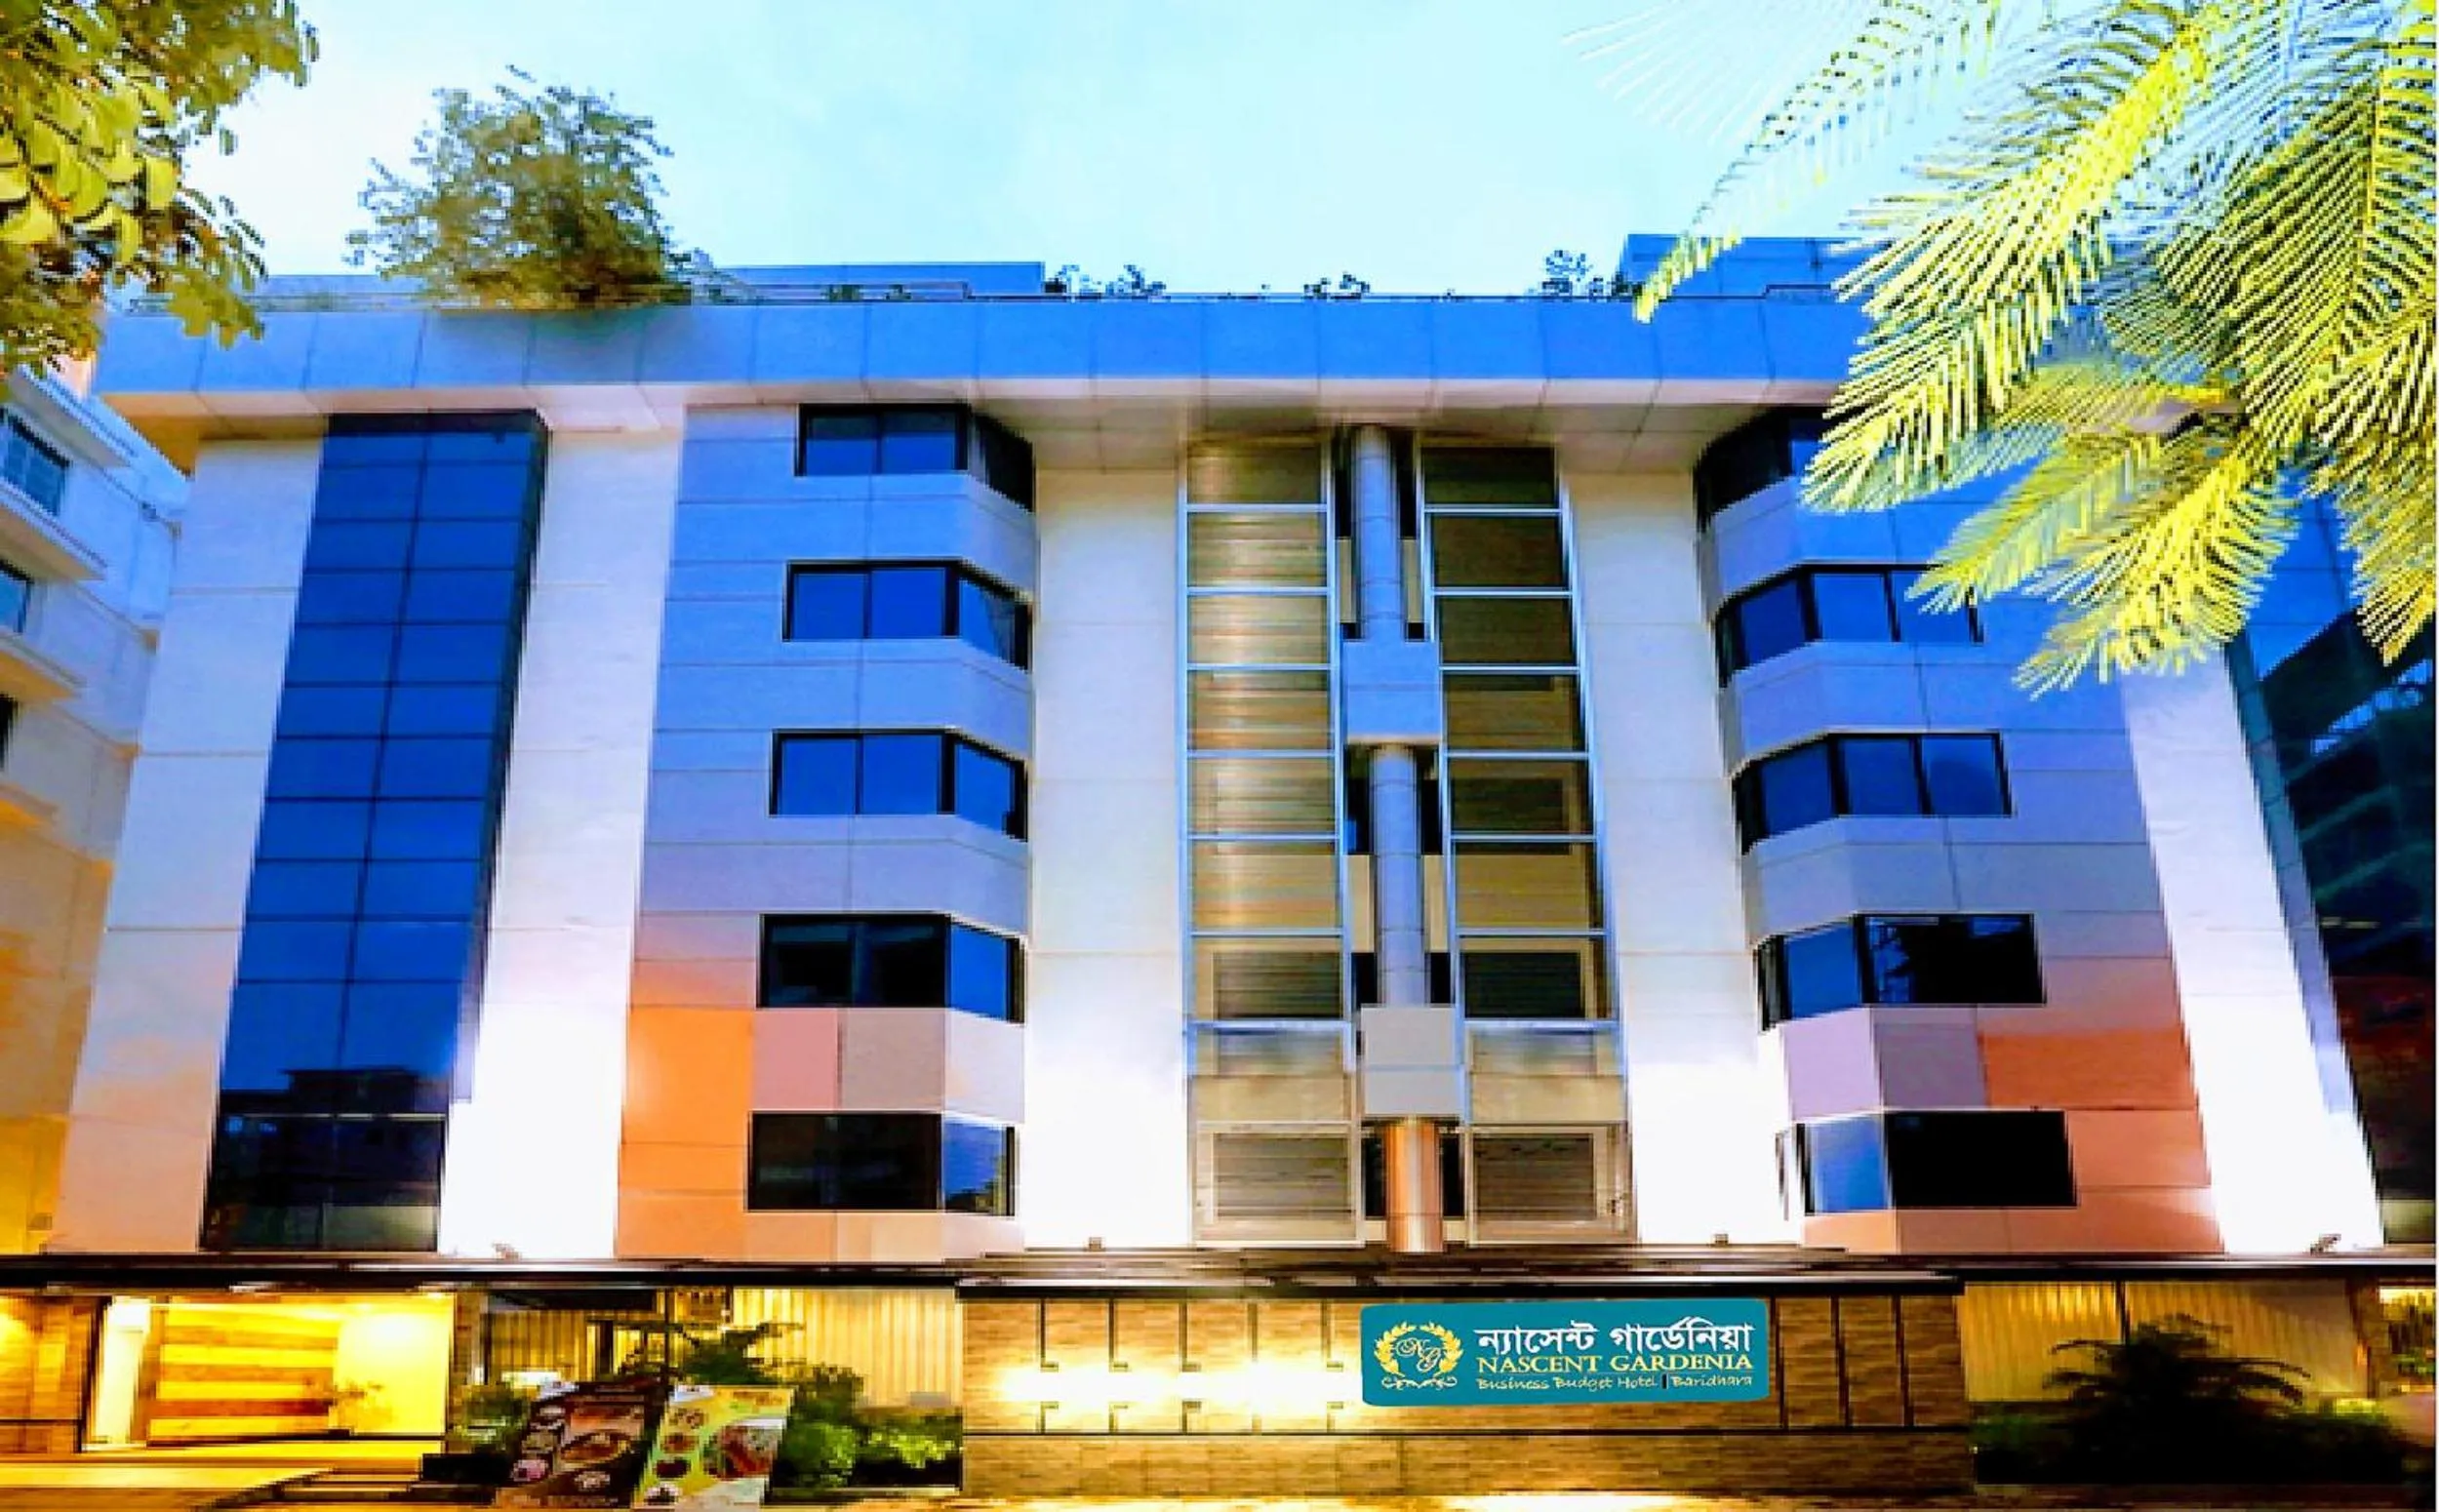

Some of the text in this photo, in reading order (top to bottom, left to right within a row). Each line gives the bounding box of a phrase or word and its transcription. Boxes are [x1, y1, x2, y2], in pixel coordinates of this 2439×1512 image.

[1473, 1316, 1755, 1355] ন্যাসেন্ট গার্ডেনিয়া
[1476, 1353, 1753, 1373] NASCENT GARDENIA
[1476, 1373, 1753, 1392] Business Budget Hotel Baridhara
